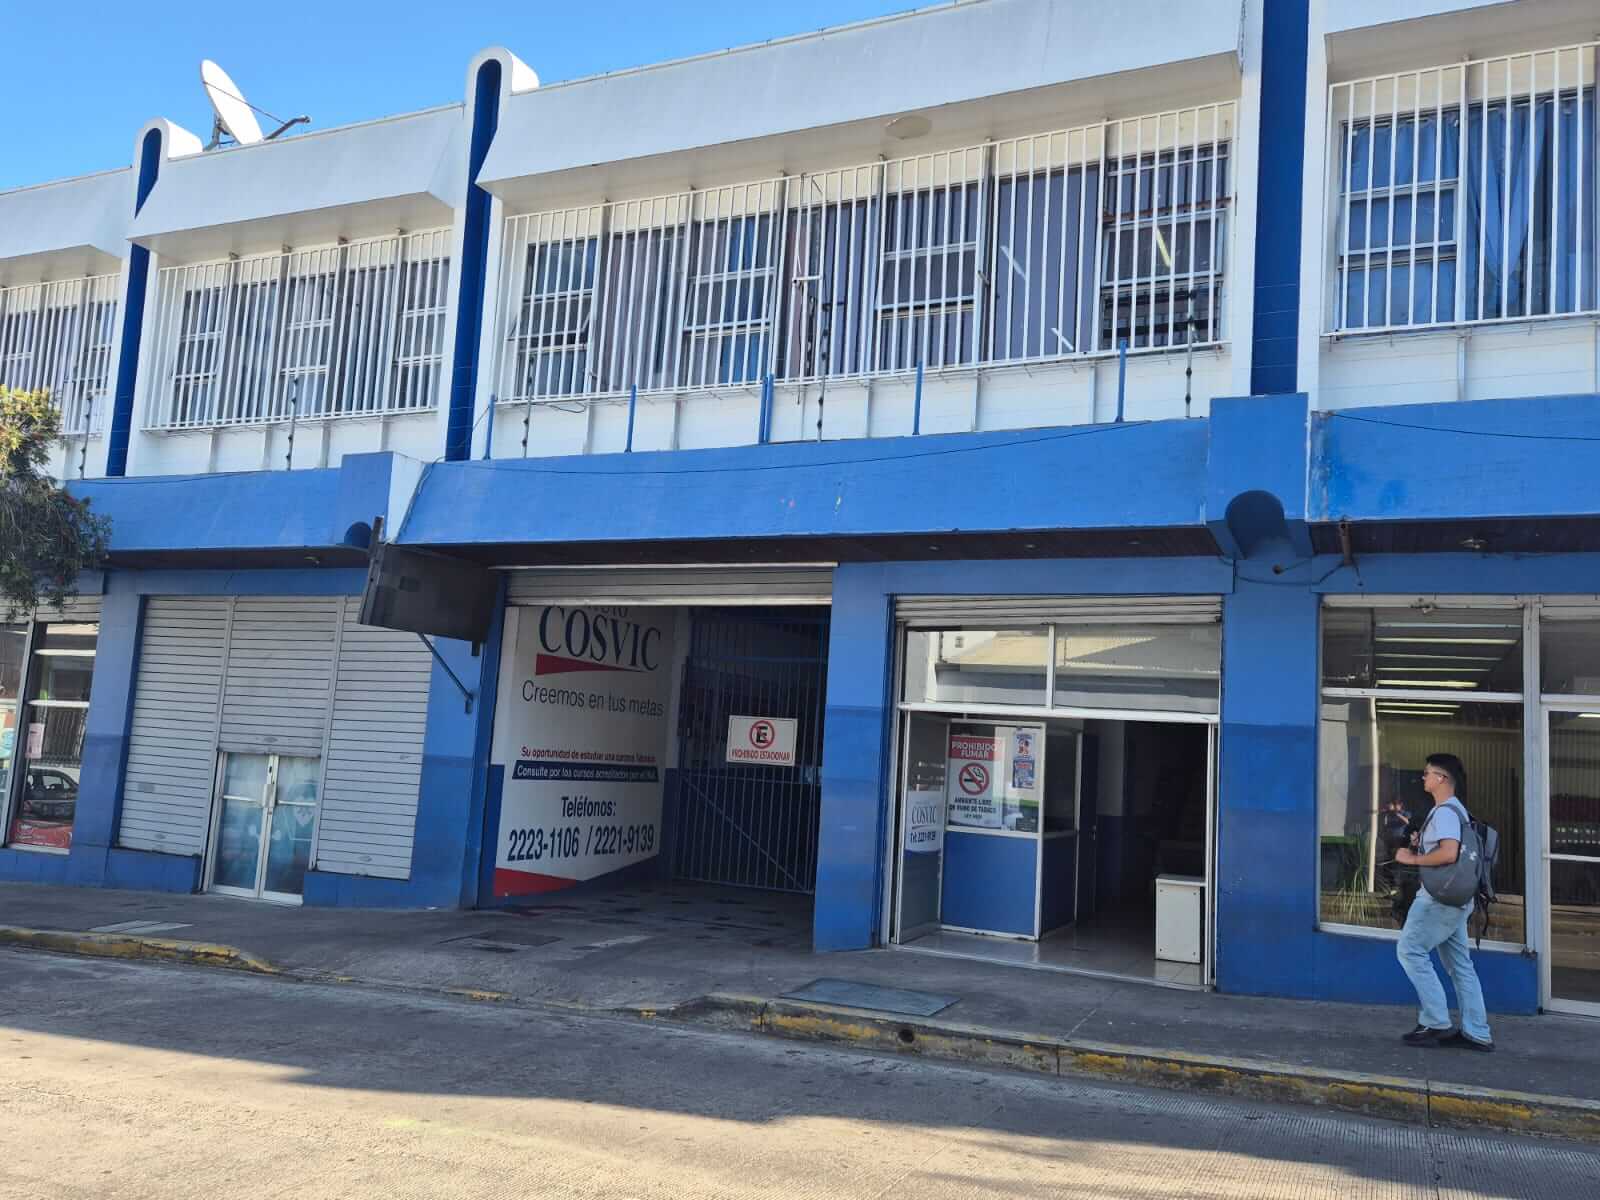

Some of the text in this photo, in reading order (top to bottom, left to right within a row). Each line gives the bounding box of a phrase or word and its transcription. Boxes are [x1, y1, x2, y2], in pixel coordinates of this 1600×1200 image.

[539, 605, 661, 671] COSVIC
[522, 680, 664, 717] Creemos en tus metas
[952, 741, 997, 752] PROHIBIDO
[961, 750, 989, 759] FUMAR
[517, 765, 548, 777] Consulte
[562, 794, 616, 818] Teléfonos:
[507, 827, 579, 862] 2223-1106
